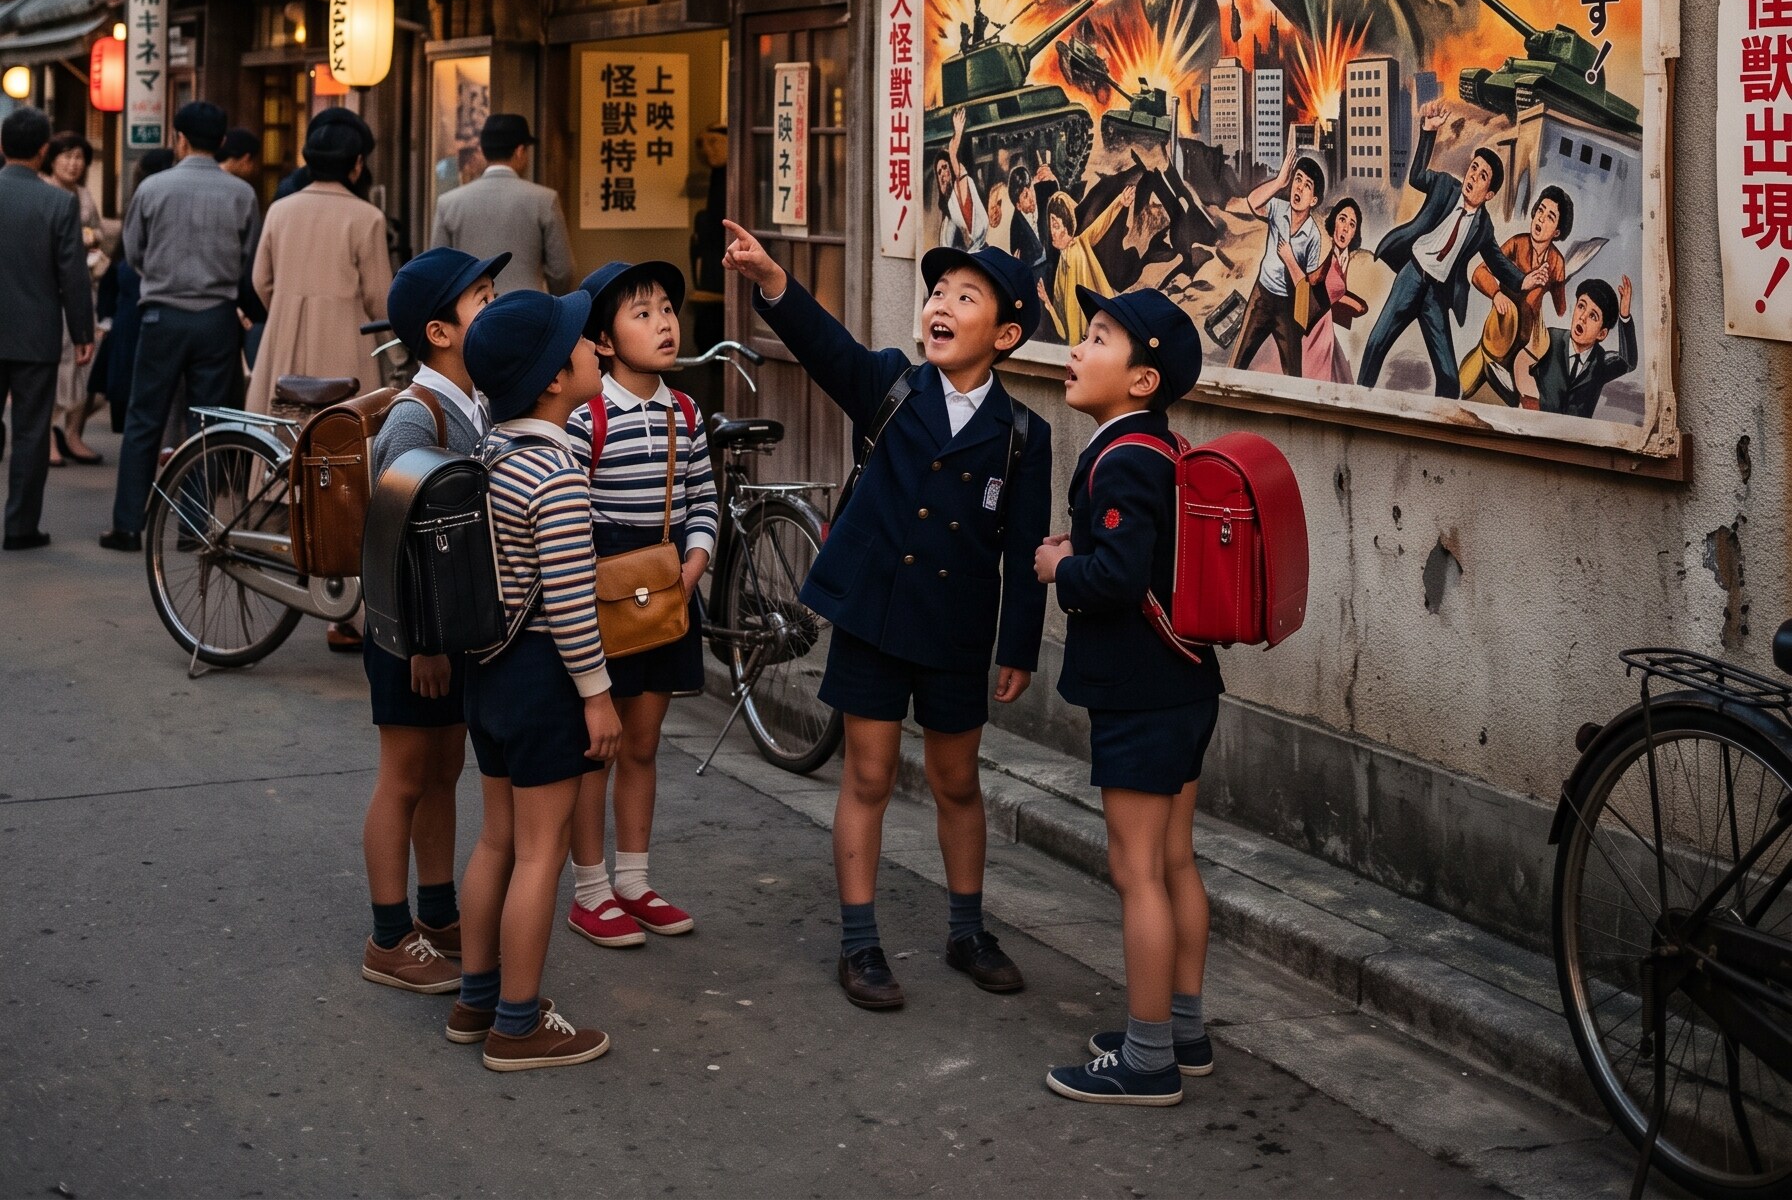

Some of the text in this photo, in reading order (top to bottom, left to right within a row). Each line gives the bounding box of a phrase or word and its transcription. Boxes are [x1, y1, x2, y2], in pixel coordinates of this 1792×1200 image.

[600, 63, 637, 213] 怪獣特撮
[646, 65, 675, 165] 上映中
